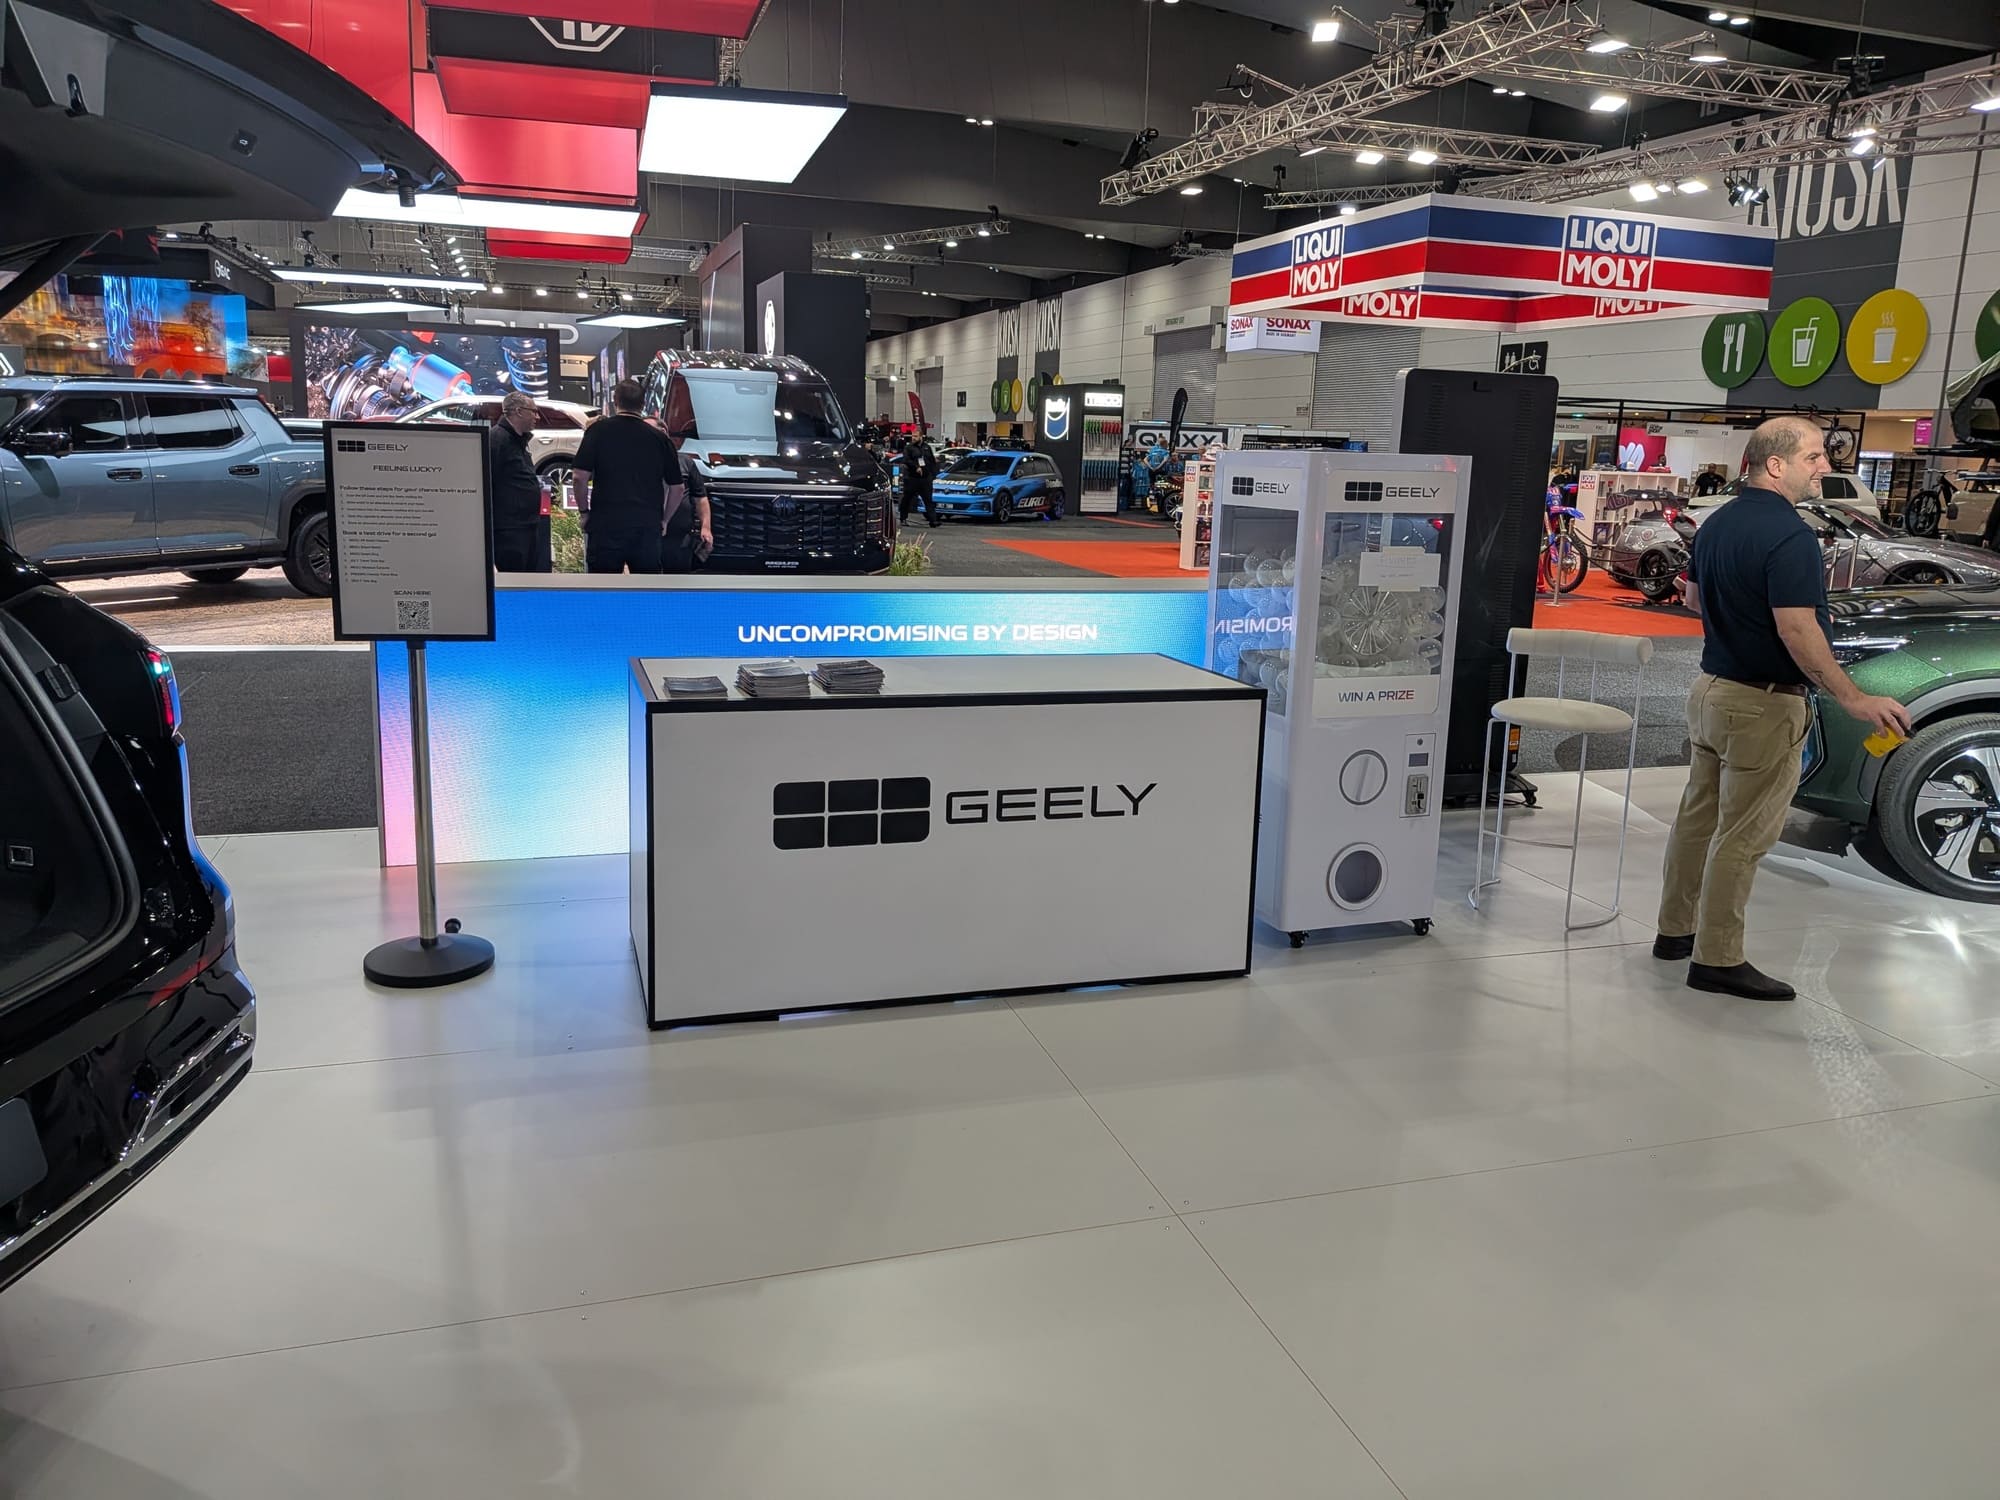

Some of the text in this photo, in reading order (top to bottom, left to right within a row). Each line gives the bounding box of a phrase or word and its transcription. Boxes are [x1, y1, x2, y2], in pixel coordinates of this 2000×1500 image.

[1752, 102, 1910, 239] KIOSK
[1295, 227, 1341, 264] LIQUI
[1570, 218, 1649, 254] LIQUI
[1293, 260, 1340, 295] MOLY
[1566, 254, 1649, 288] MOLY
[1348, 291, 1417, 316] MOLY
[998, 309, 1020, 358] KIOSK
[1036, 297, 1061, 352] KIOSK
[1231, 316, 1254, 331] SONAX
[1266, 317, 1311, 331] SONAX
[367, 443, 409, 451] GEELY
[410, 465, 442, 473] LUCKY?
[1255, 482, 1290, 495] GEELY
[1386, 487, 1440, 498] GEELY
[1018, 496, 1046, 508] EURO
[738, 624, 1098, 643] UNCOMPROMISING BY DESIGN
[1338, 690, 1415, 702] WIN A PRIZE
[945, 783, 1158, 825] GEELY
